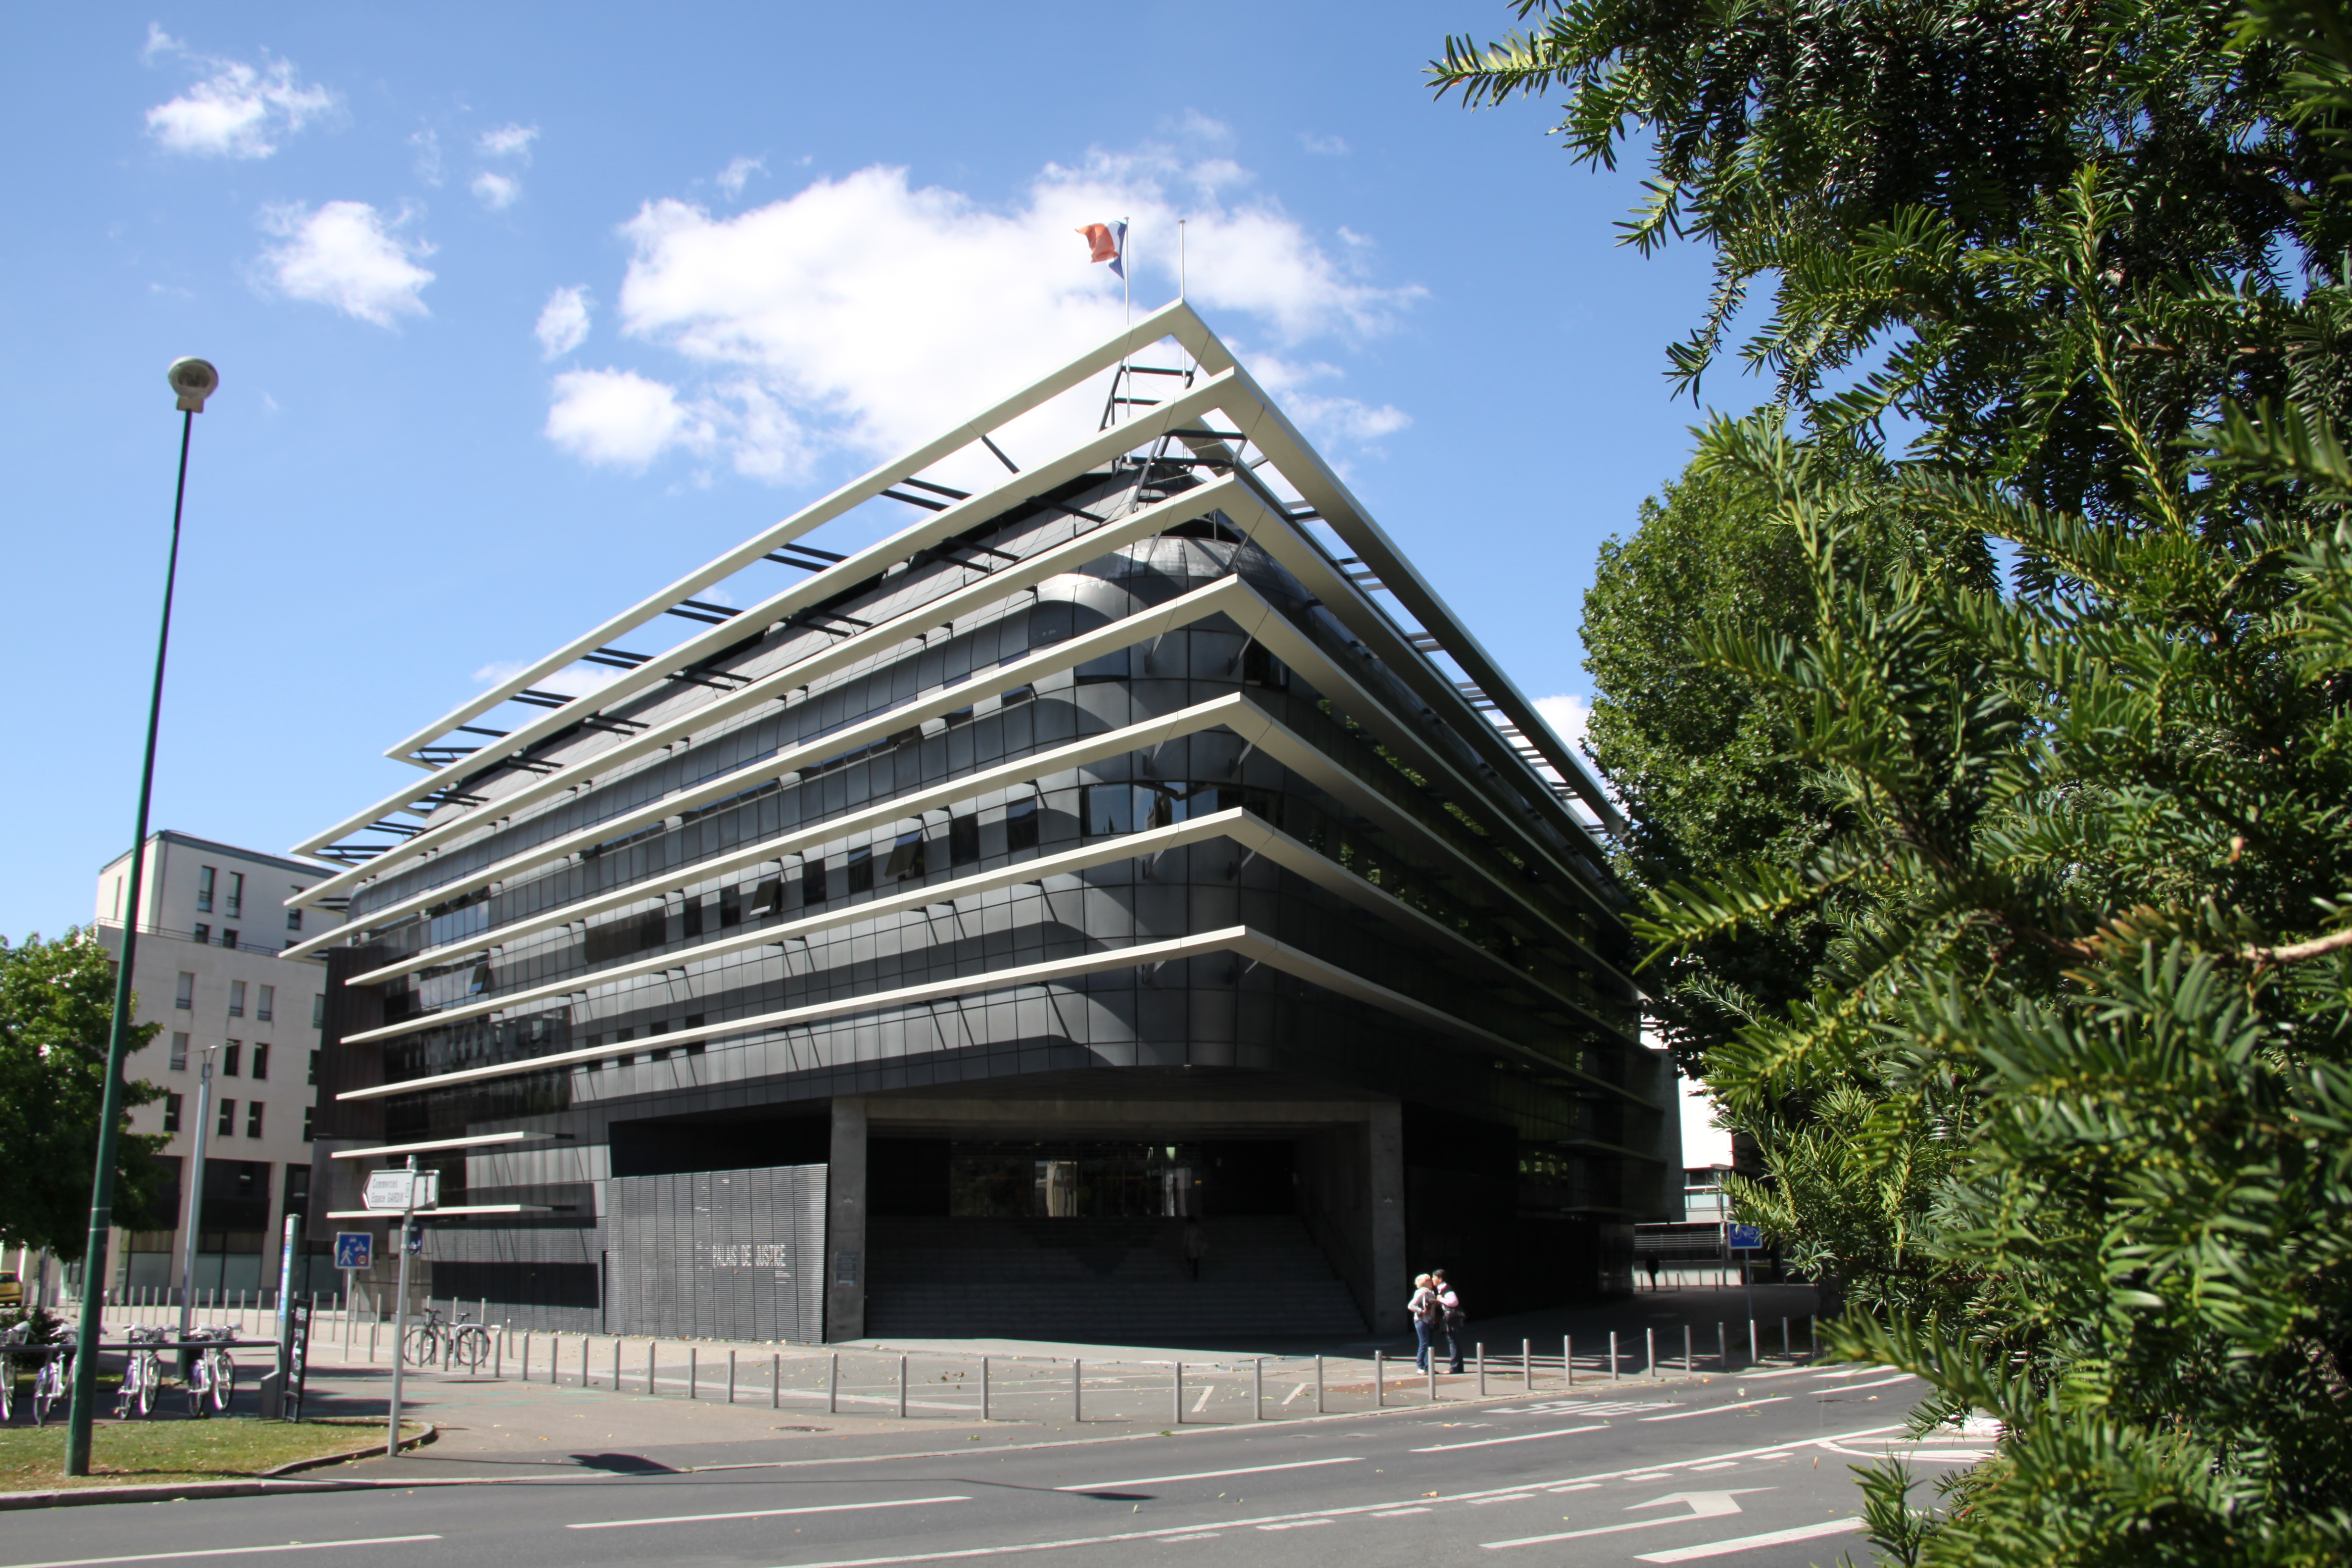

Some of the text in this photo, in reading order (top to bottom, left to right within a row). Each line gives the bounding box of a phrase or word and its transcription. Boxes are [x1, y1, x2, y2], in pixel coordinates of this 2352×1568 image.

[373, 1178, 398, 1188] Commerces
[371, 1192, 386, 1205] Espace
[712, 1244, 786, 1267] PALAIS DE JUSTICE
[1481, 1400, 1686, 1417] BUS
